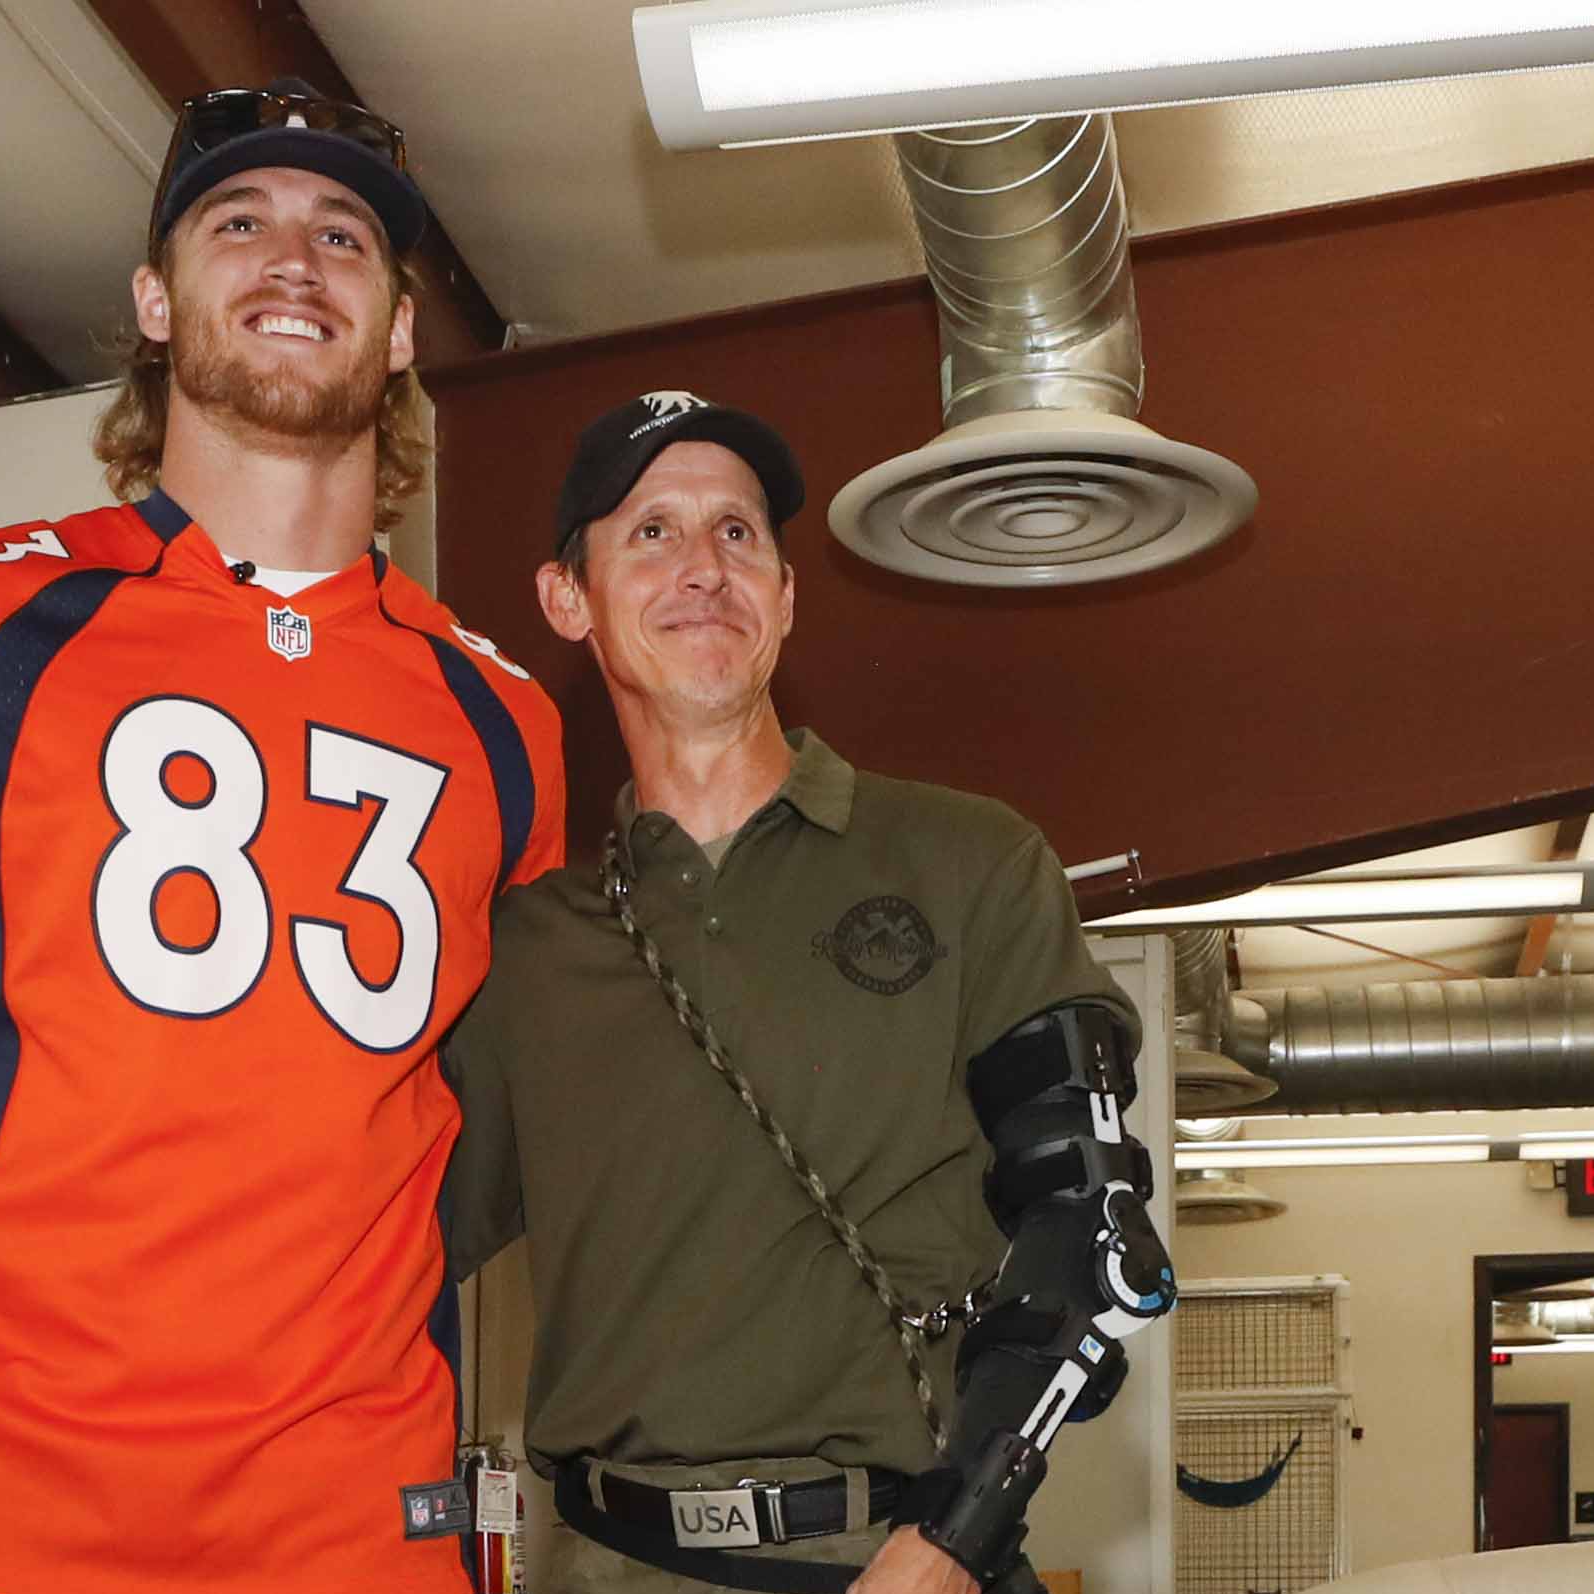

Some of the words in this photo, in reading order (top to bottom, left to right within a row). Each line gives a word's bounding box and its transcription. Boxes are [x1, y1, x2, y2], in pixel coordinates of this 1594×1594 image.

[275, 626, 305, 649] NFL
[91, 693, 452, 1055] 83
[678, 1505, 751, 1535] USA
